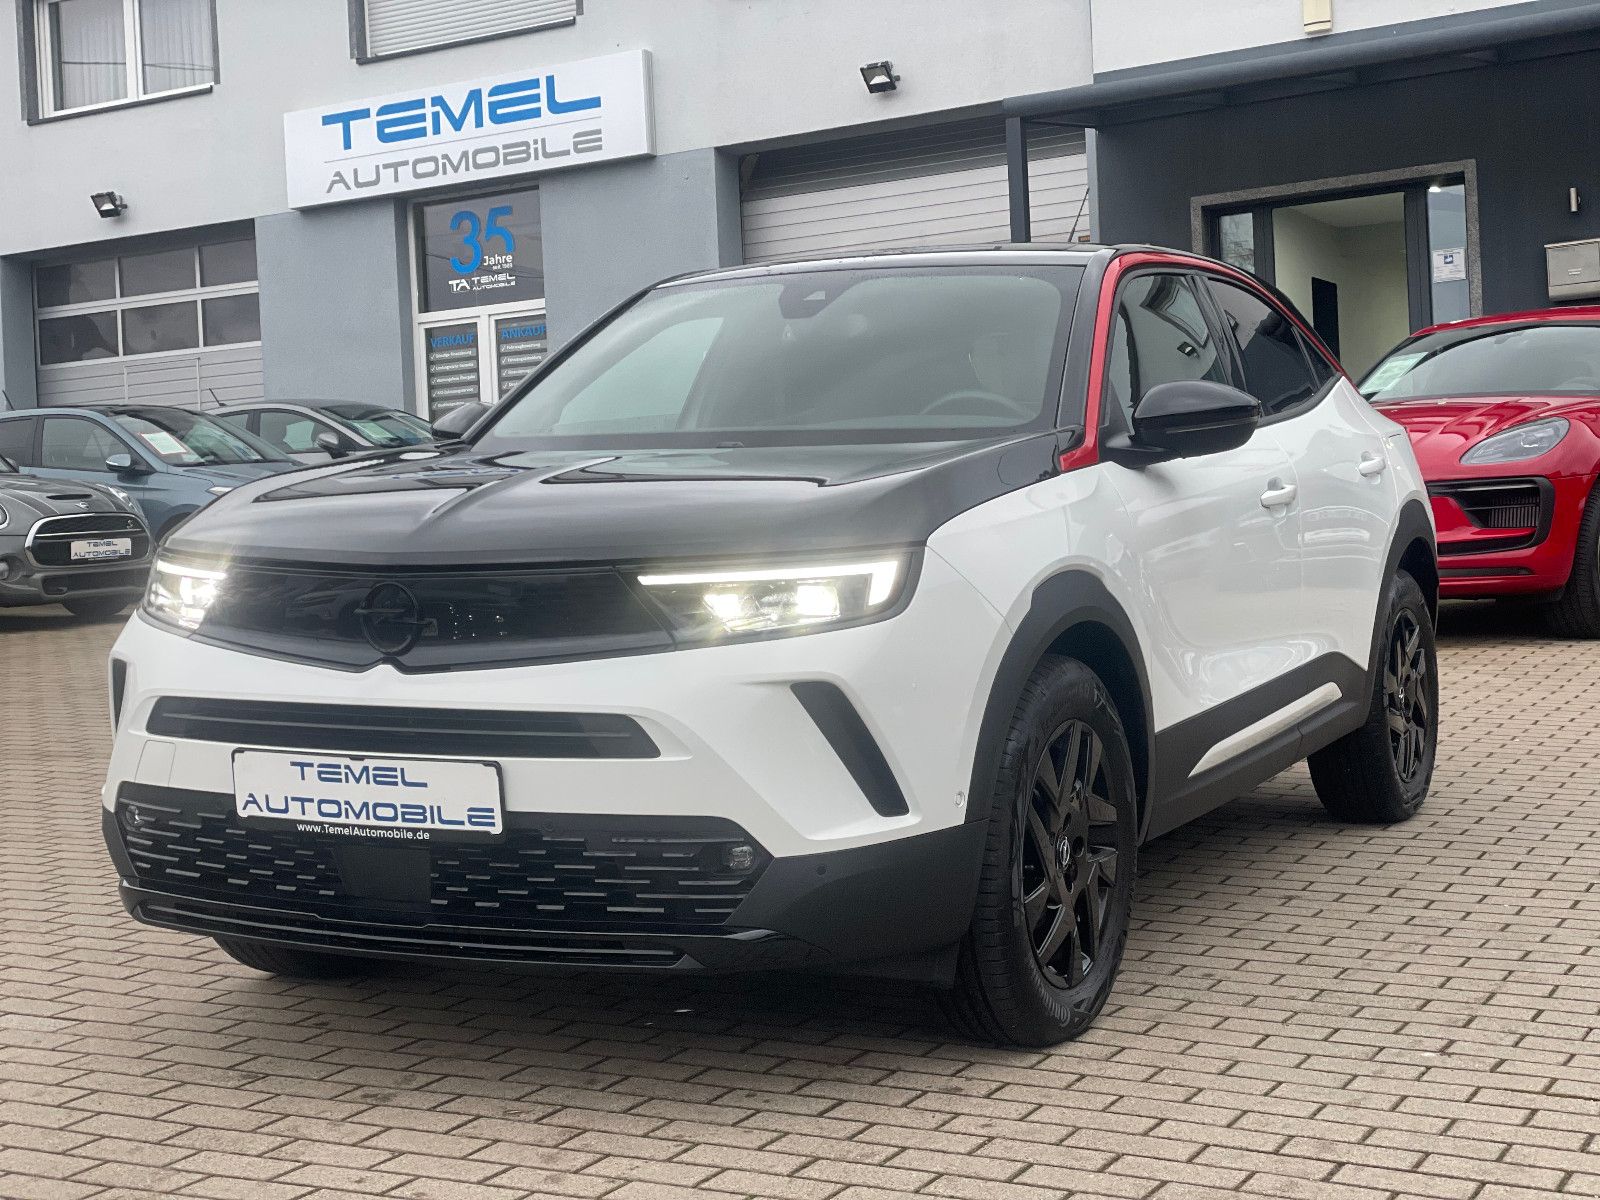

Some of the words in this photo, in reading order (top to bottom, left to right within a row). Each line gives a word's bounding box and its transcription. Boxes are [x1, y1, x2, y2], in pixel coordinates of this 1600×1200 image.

[322, 75, 601, 150] TEMEL
[450, 205, 515, 275] 35
[483, 254, 513, 266] Jahre
[471, 272, 516, 285] TEMEL
[430, 333, 475, 348] VERKAUF
[87, 540, 118, 548] TEMEL
[289, 760, 428, 788] TEMEL
[242, 792, 496, 828] AUTOMOBILE
[296, 822, 430, 841] www.TemelAutomobile.de
